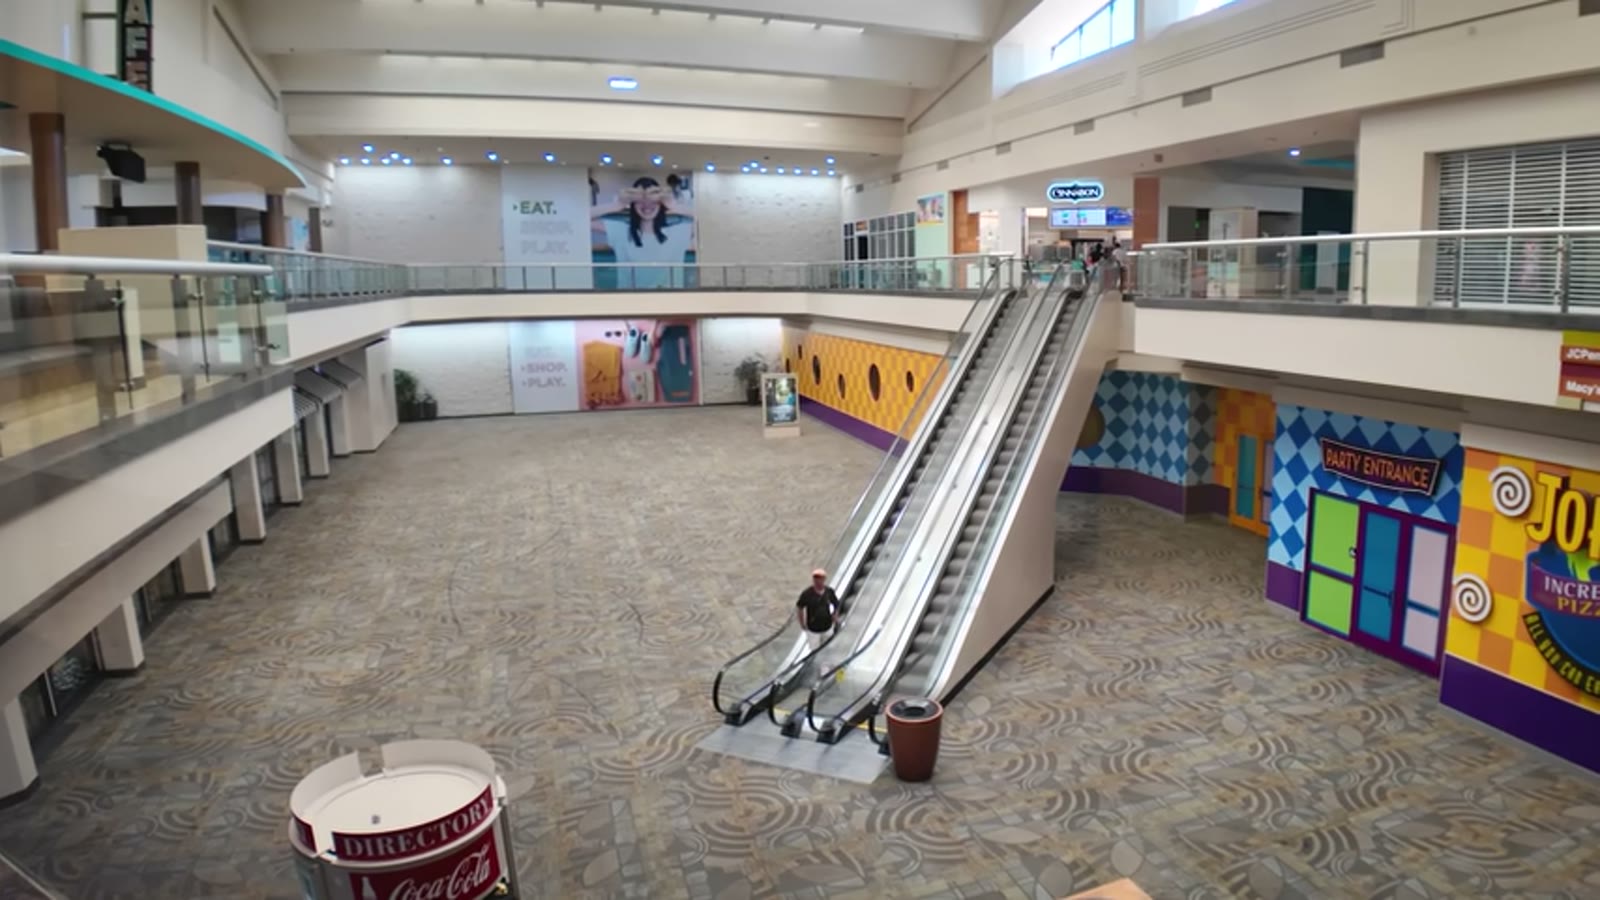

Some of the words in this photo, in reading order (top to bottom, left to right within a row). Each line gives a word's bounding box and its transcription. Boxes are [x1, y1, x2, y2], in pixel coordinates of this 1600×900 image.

[520, 201, 557, 215] EAT.
[1325, 449, 1361, 472] PARTY
[1363, 457, 1430, 488] ENTRANCE
[343, 796, 493, 857] DIRECTORY
